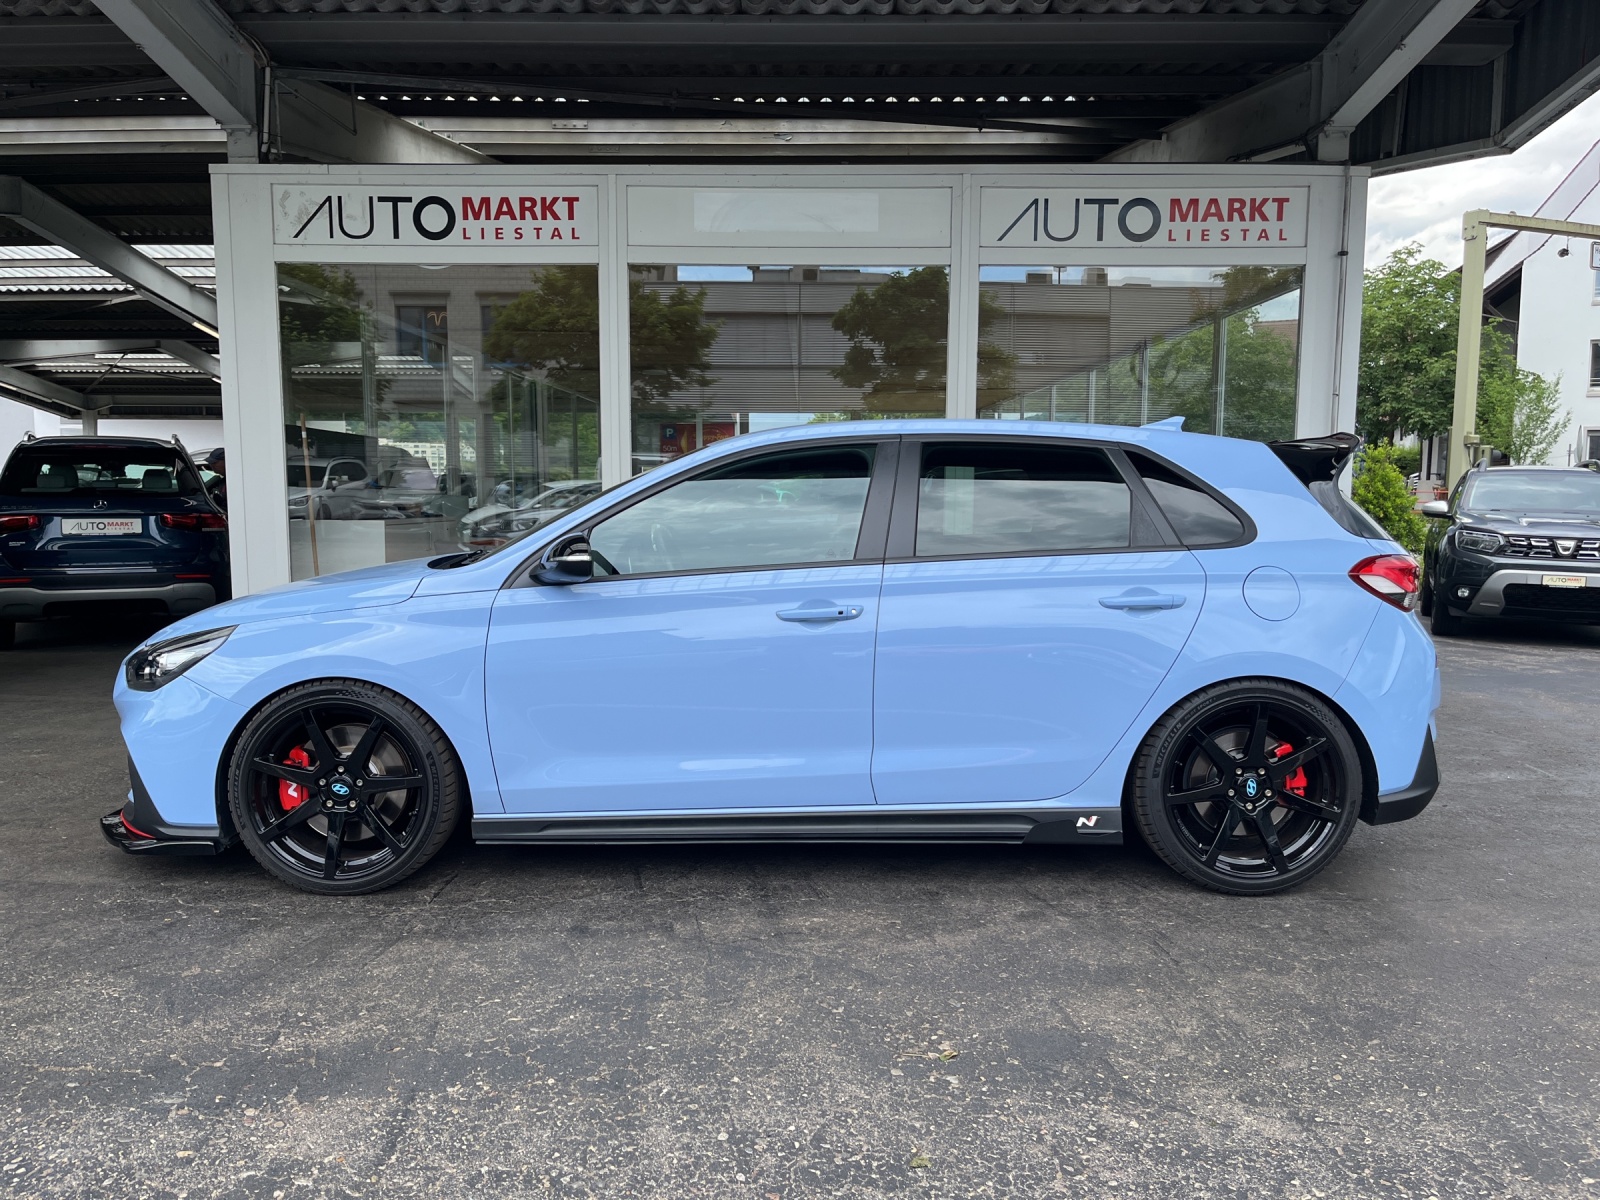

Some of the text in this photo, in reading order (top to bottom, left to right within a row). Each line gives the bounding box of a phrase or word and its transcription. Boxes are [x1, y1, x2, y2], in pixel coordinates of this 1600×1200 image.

[293, 195, 580, 241] AUTO MARKT
[996, 197, 1290, 243] AUTO MARKT
[462, 227, 580, 240] LIESTAL
[1168, 228, 1288, 242] LIESTAL
[666, 428, 674, 437] P
[70, 521, 107, 531] AUTO
[1156, 723, 1182, 765] MICHELIN
[430, 765, 439, 813] MICHELIN
[1075, 815, 1099, 827] N
